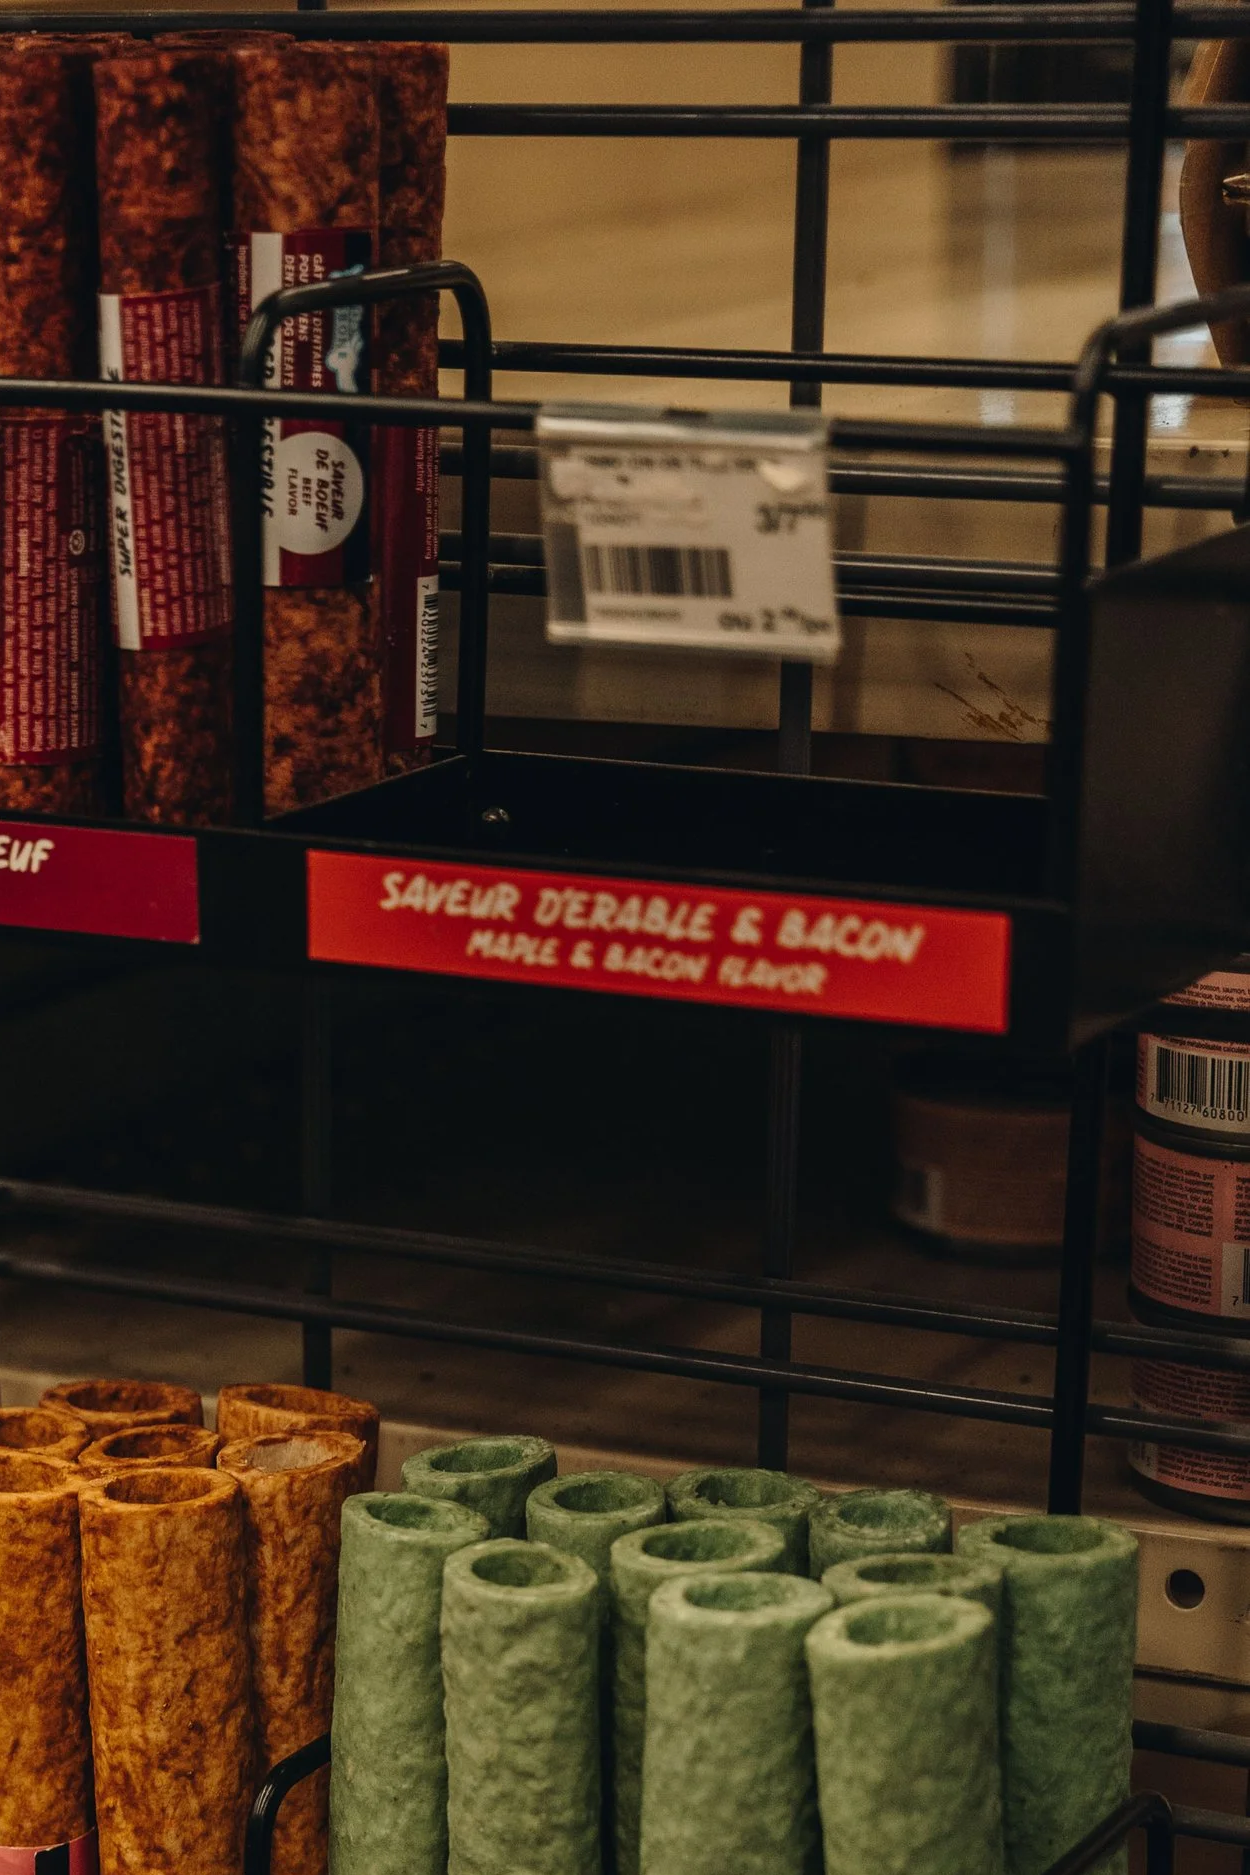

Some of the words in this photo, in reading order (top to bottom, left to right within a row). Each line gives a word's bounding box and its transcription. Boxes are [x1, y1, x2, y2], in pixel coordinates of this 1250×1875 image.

[282, 340, 294, 387] TREATS
[311, 318, 323, 388] DENTAIRES
[315, 448, 329, 471] DE
[287, 468, 298, 516] FLAVOR
[302, 477, 312, 507] BEEF
[314, 479, 330, 533] BOEUF
[330, 460, 346, 521] SAVEUR
[114, 506, 133, 577] SUPER
[421, 611, 430, 653] 40224
[379, 871, 522, 920] SAVEUR
[731, 905, 762, 945] &
[776, 909, 926, 965] BACON
[466, 928, 561, 968] MAPLE
[569, 933, 594, 968] &
[603, 942, 710, 984] BACON
[717, 955, 829, 996] FLAVOR
[1164, 1099, 1197, 1115] 71127
[1202, 1107, 1245, 1122] 60800
